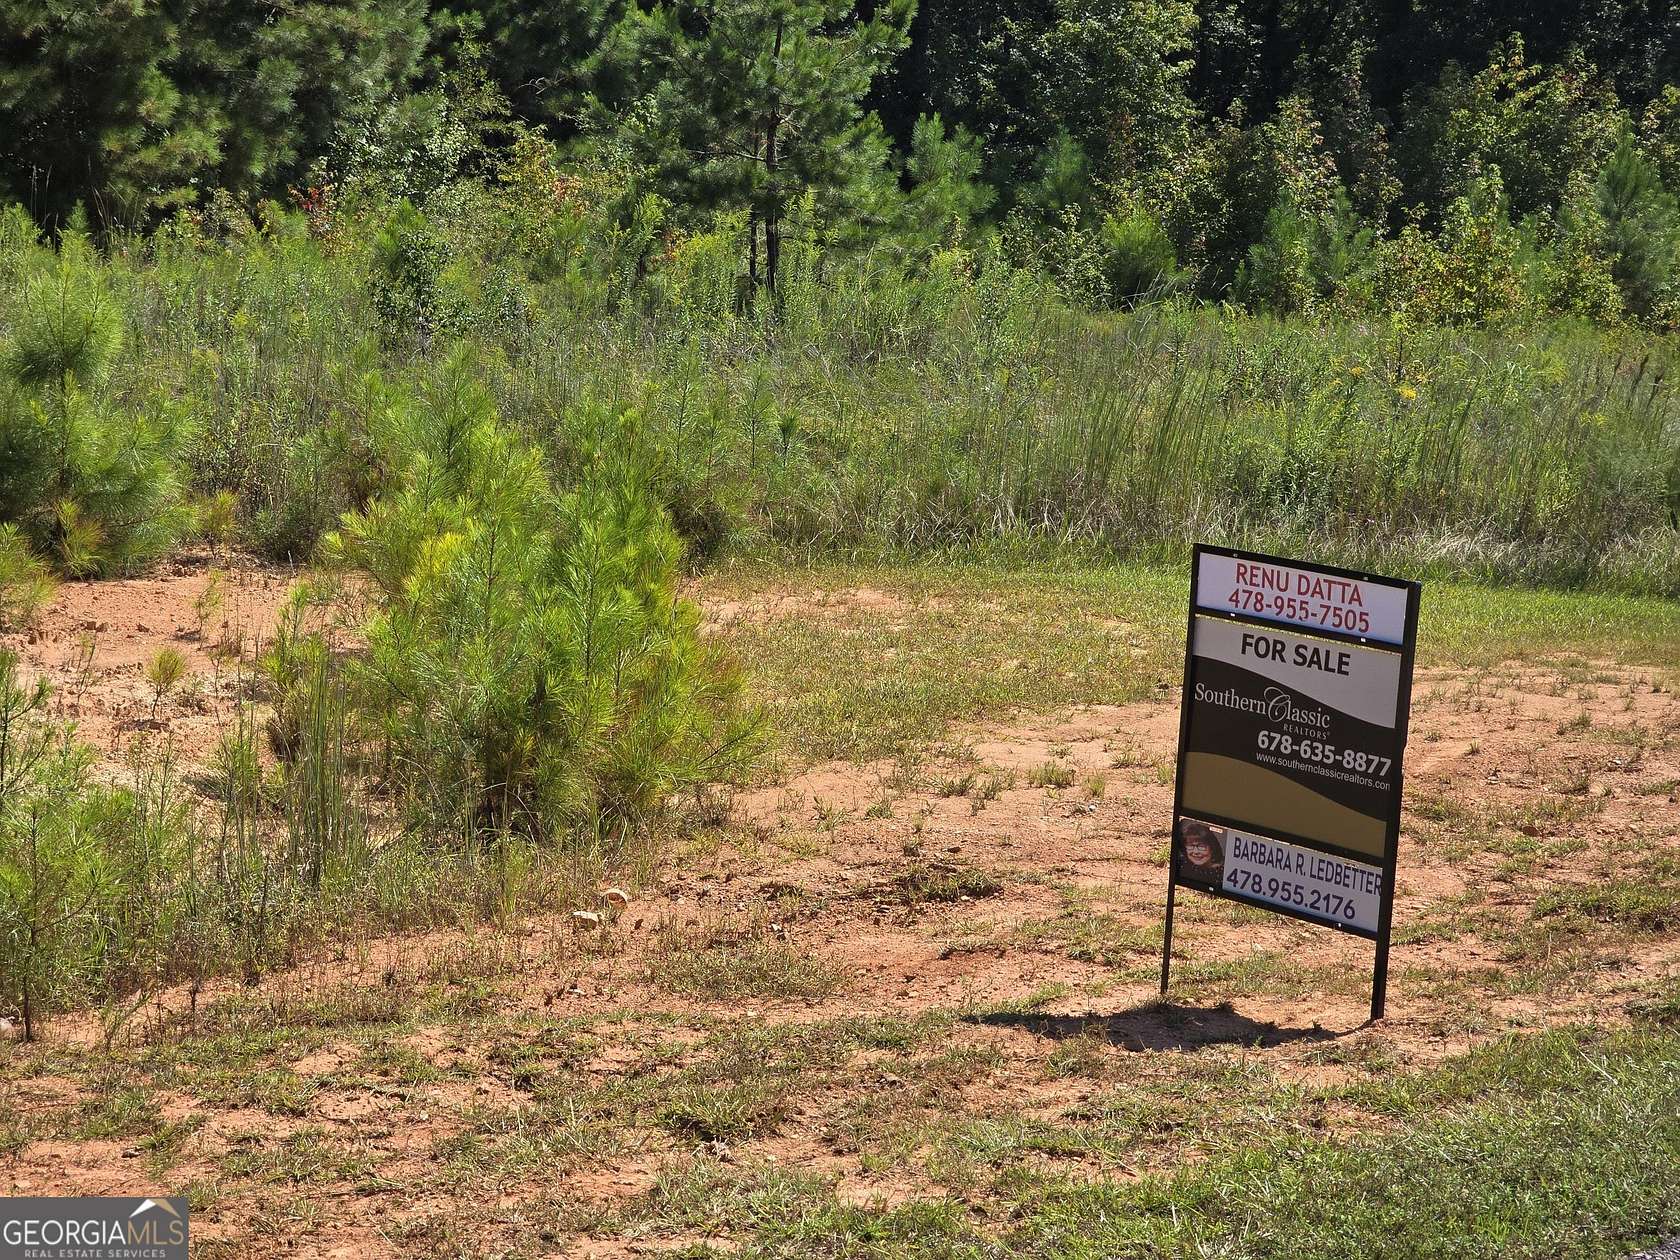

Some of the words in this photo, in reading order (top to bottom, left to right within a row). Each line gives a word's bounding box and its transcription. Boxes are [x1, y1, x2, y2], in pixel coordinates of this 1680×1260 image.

[1236, 562, 1290, 593] RENU
[1297, 573, 1363, 607] DATTA
[1228, 587, 1370, 634] 478-955-7505
[1240, 633, 1287, 664] FOR
[1293, 644, 1351, 676] SALE
[1194, 682, 1267, 716] Southern
[1264, 686, 1330, 728] Classic
[1257, 730, 1392, 777] 678-635-8877
[1233, 836, 1292, 873] BARBARA
[1296, 853, 1307, 877] R.
[1309, 857, 1383, 897] LEDBETTER
[1226, 867, 1356, 920] 478.955.2176
